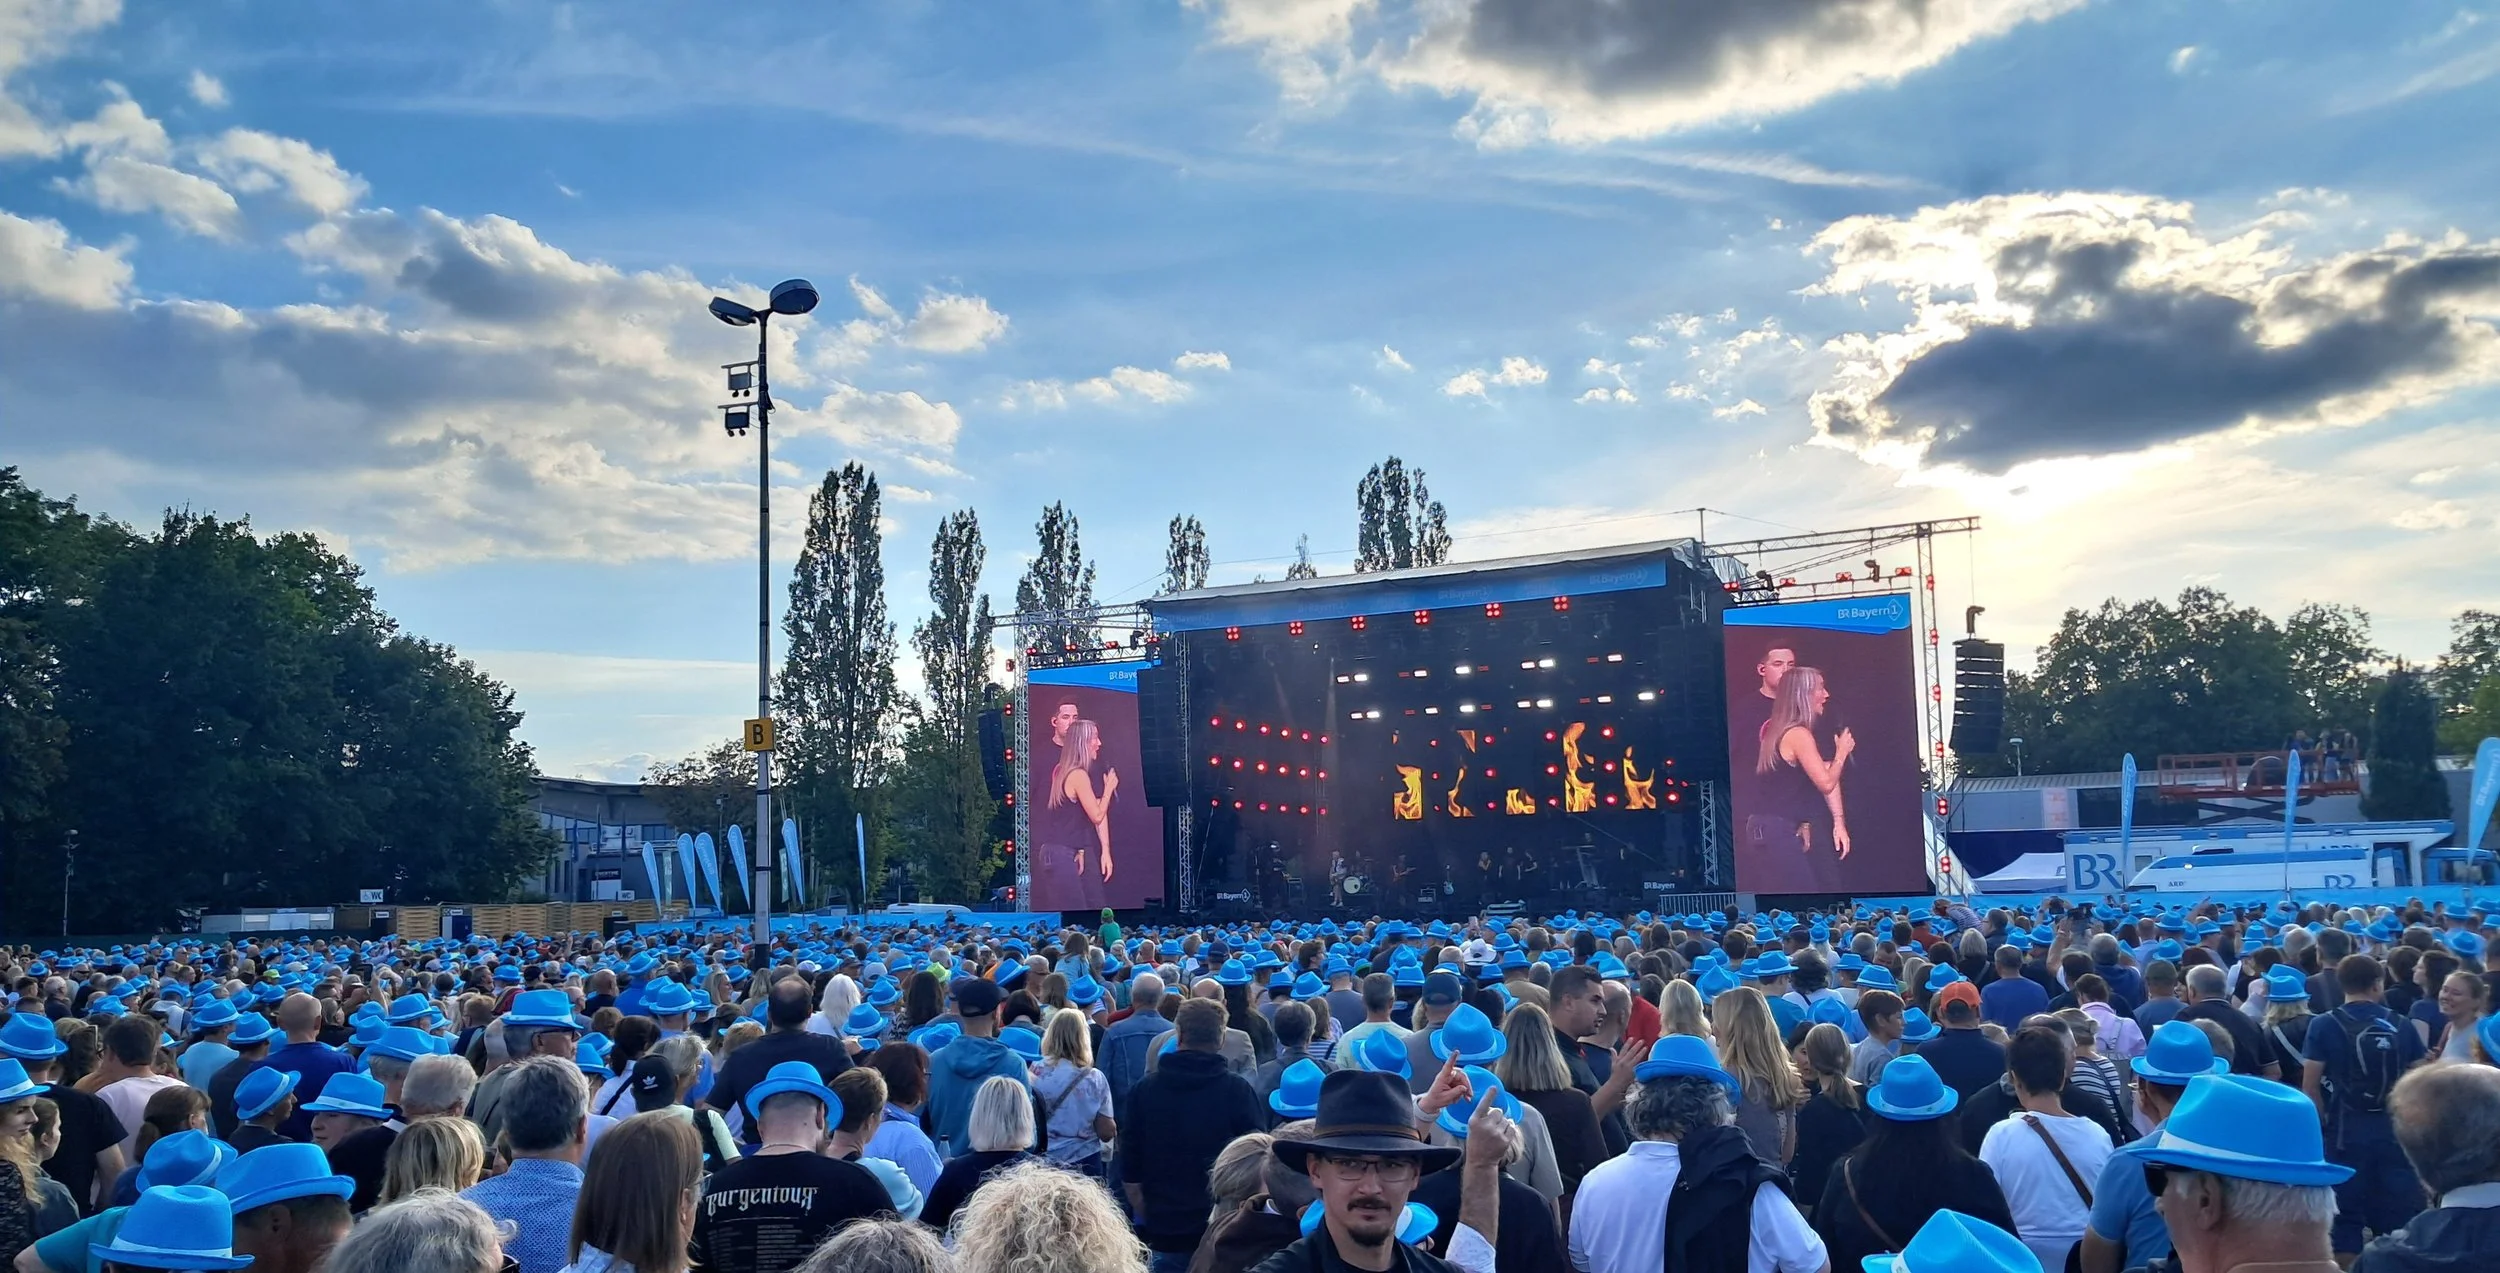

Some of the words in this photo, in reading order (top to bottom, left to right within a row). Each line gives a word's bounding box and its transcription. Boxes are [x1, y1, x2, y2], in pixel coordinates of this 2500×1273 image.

[1837, 609, 1850, 619] BR
[1851, 607, 1890, 620] Bayern
[1118, 671, 1137, 681] Baye
[753, 724, 763, 744] B
[2073, 853, 2123, 891] BR
[371, 891, 383, 900] WC
